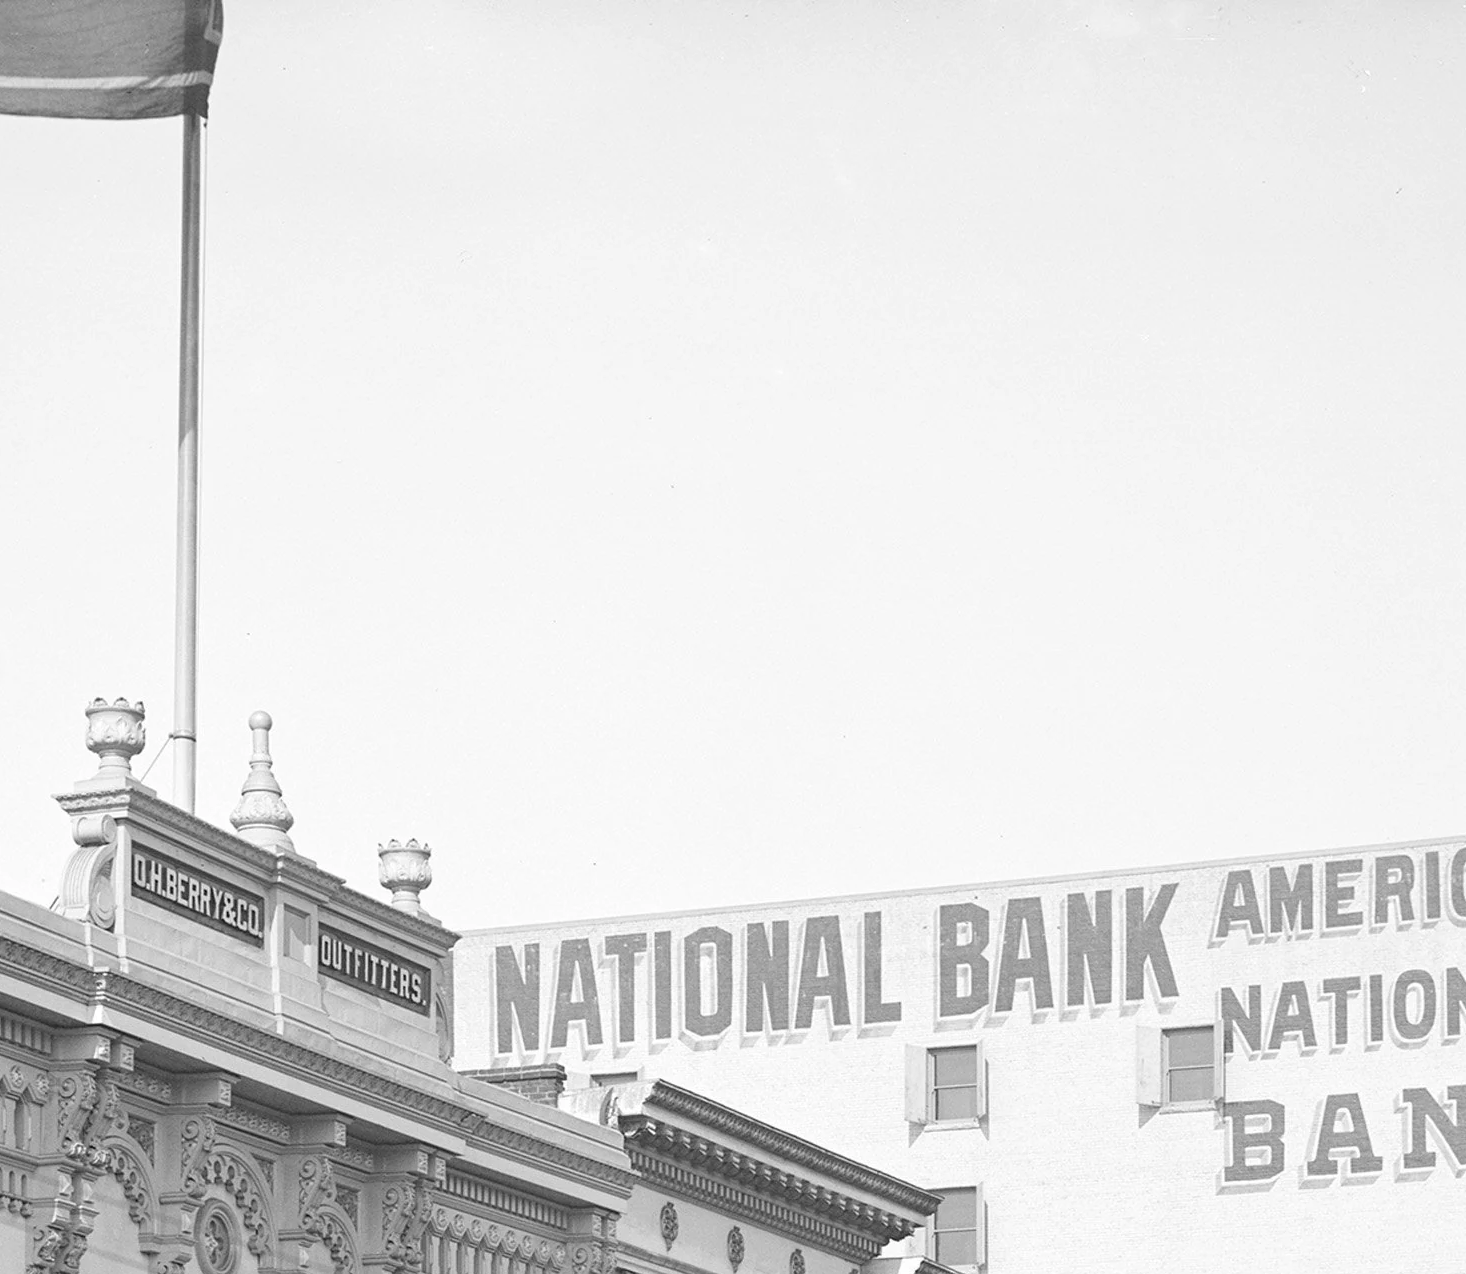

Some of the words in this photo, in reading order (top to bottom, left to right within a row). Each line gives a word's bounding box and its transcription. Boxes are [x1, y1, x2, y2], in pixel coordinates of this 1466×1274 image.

[320, 933, 427, 1006] OUTFITTERS.
[492, 910, 903, 1056] NATIONAL
[938, 883, 1181, 1020] BANK
